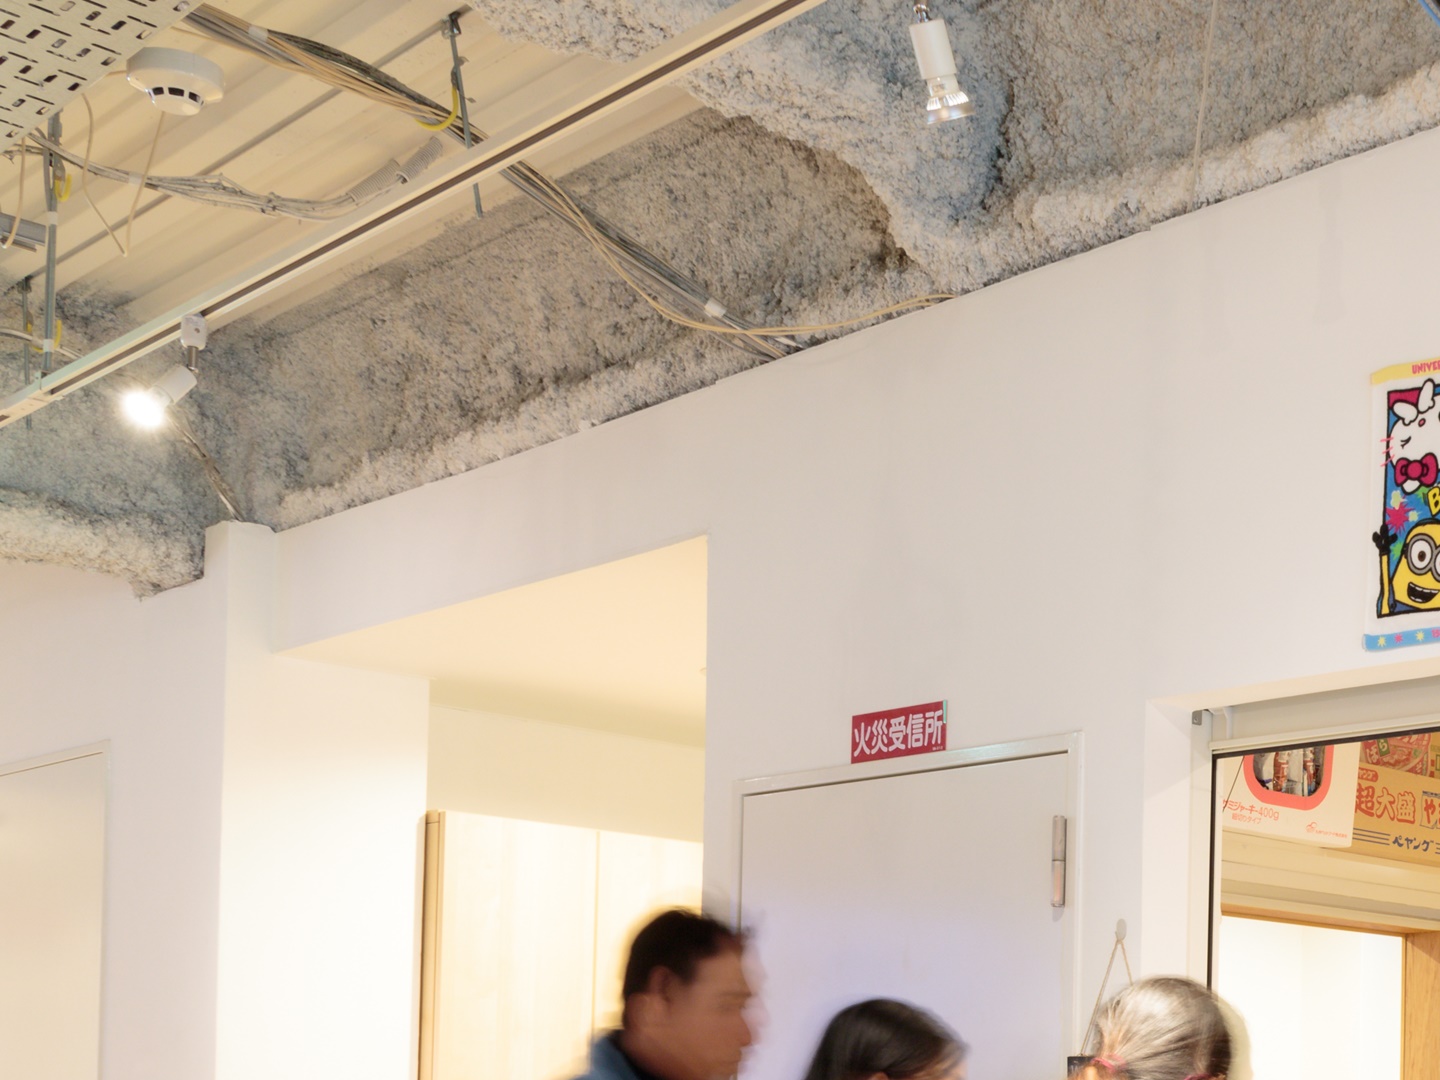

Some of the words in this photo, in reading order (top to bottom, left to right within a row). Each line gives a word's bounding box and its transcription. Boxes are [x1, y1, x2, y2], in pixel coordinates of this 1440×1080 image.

[853, 709, 944, 758] 火災受信所
[1392, 835, 1434, 852] ペヤング
